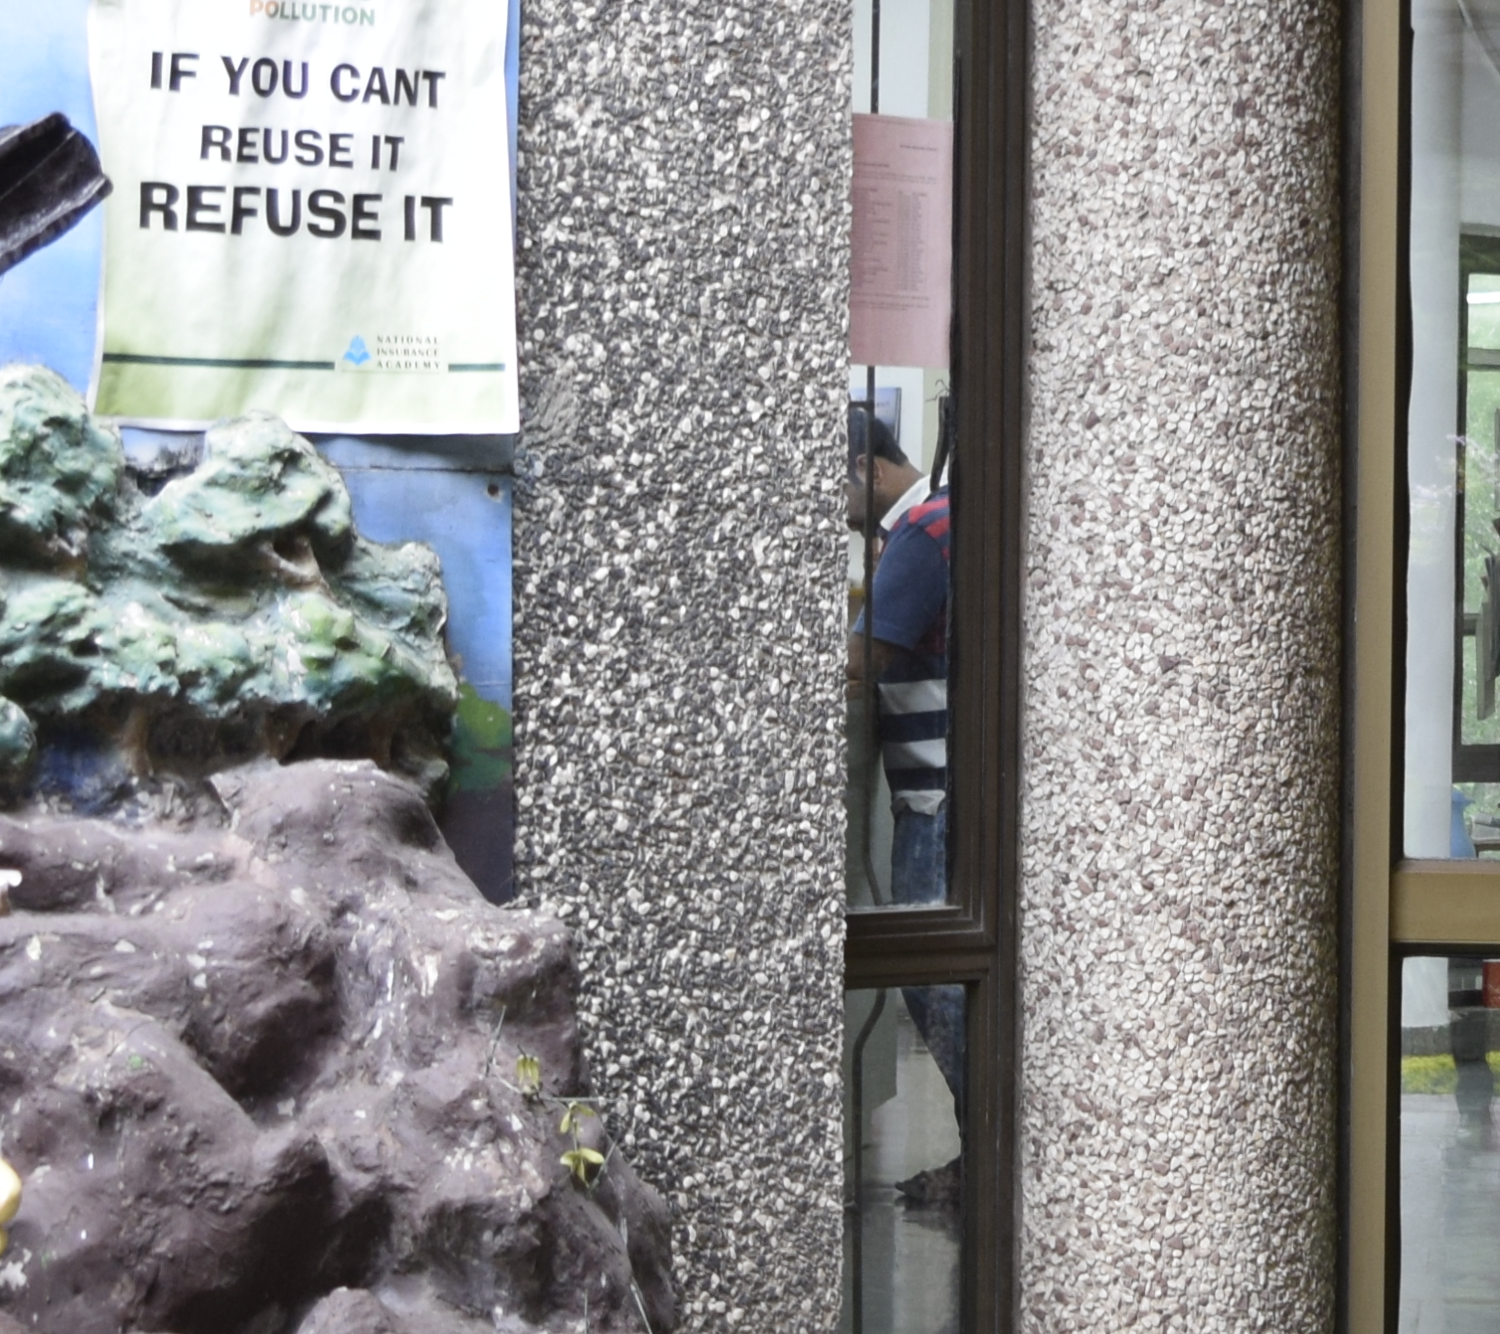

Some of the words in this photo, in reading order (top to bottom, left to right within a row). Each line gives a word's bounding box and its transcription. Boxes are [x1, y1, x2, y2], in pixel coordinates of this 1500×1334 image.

[250, 0, 376, 26] POLLUTION
[150, 51, 200, 92] IF
[221, 55, 309, 99] YOU
[329, 63, 446, 109] CANT
[200, 124, 355, 170] REUSE
[370, 134, 405, 171] IT
[139, 181, 383, 242] REFUSE
[403, 194, 454, 243] IT
[376, 334, 439, 345] NATIONAL
[376, 347, 439, 357] INSURANCE
[376, 360, 440, 370] ACADEMY
